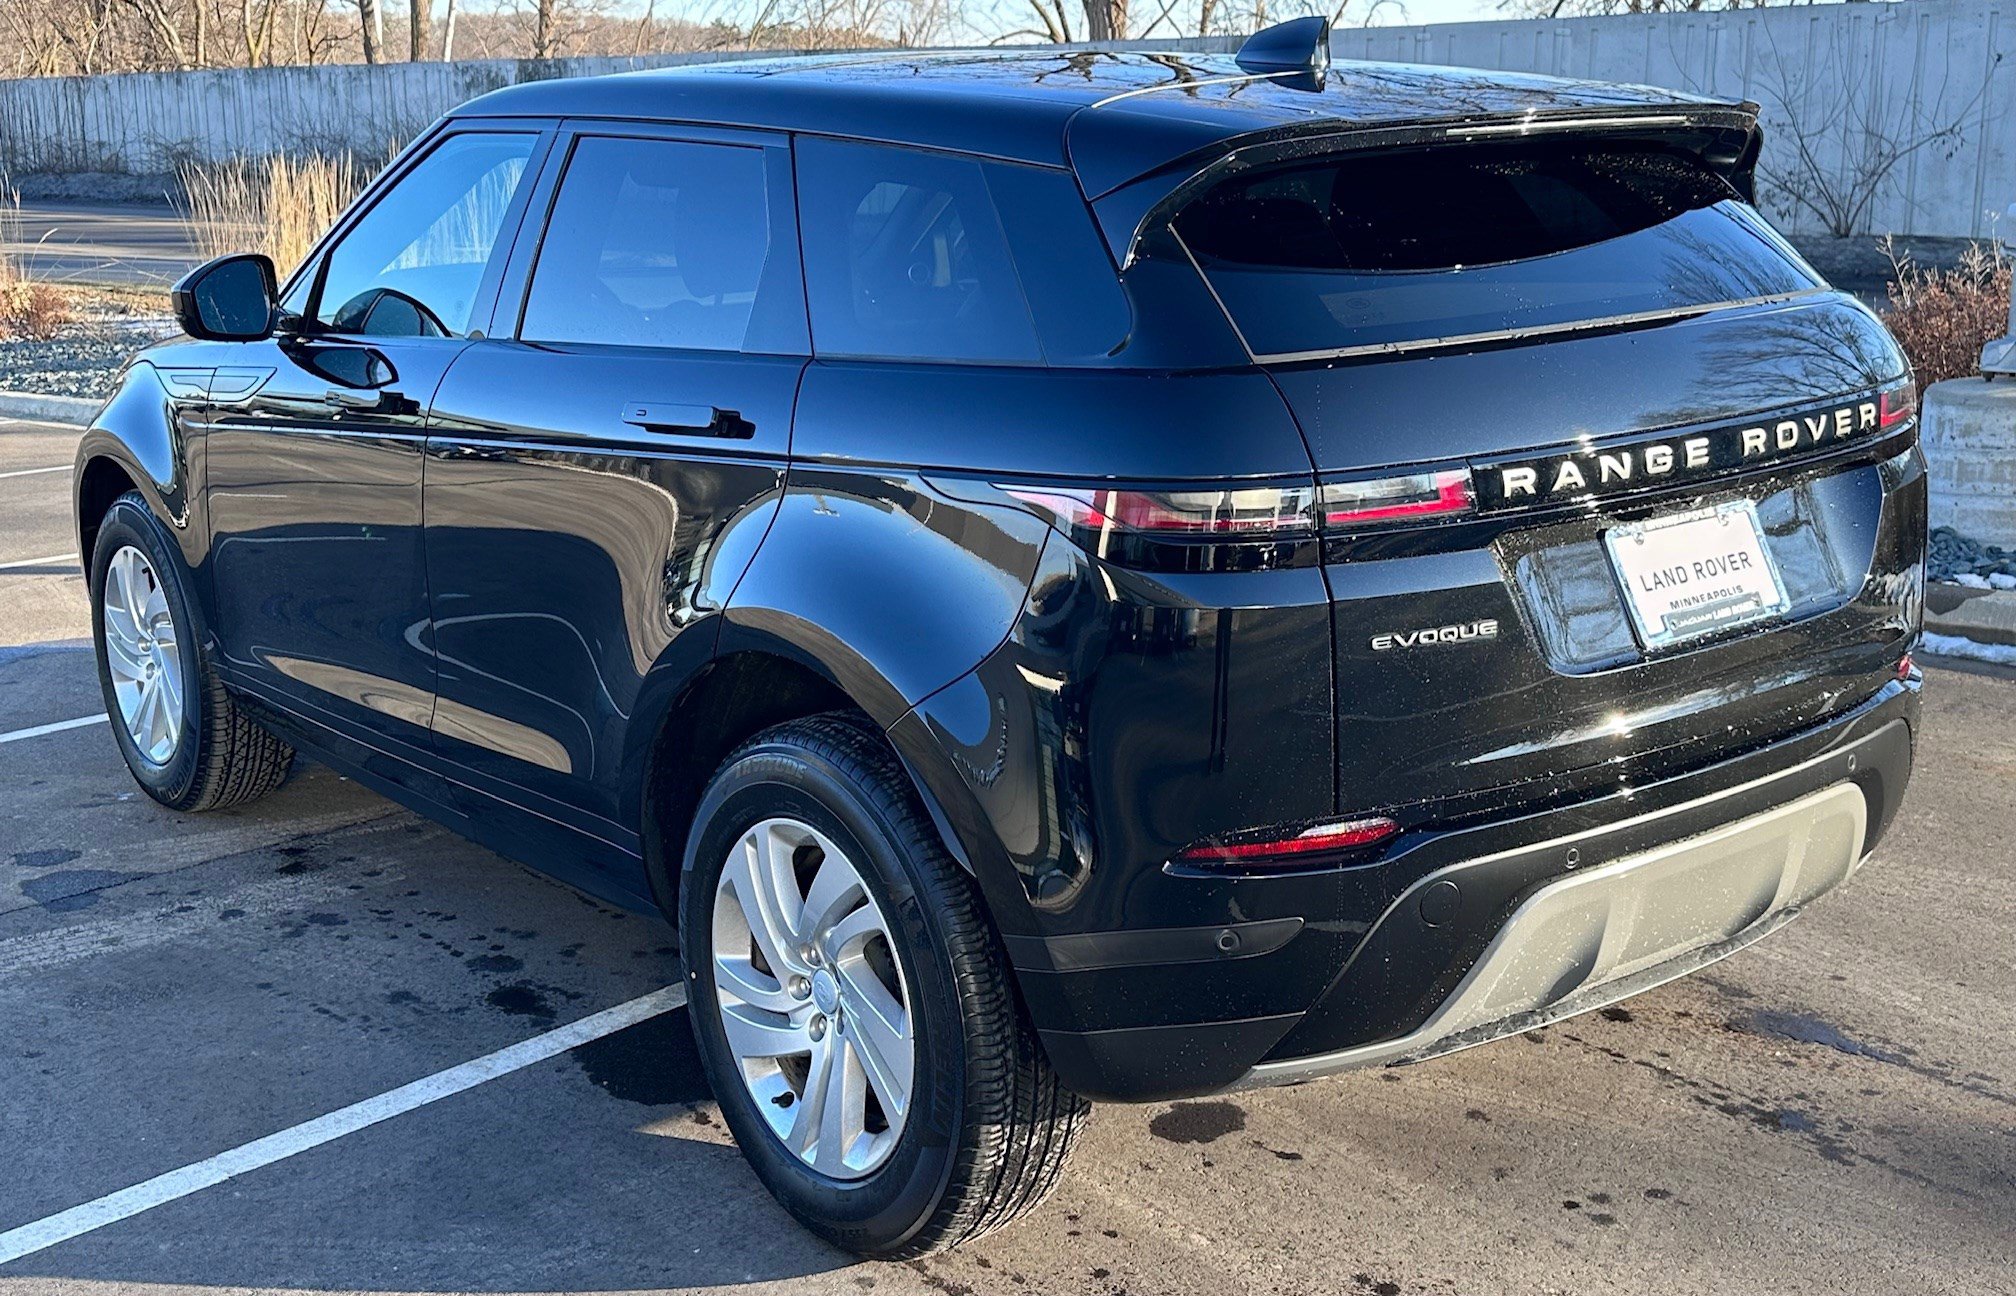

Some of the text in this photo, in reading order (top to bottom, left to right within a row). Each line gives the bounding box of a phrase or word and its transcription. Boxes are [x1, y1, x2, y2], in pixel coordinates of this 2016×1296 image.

[1501, 401, 1878, 498] RANGE ROVER
[1639, 551, 1753, 592] LAND ROVER
[1669, 584, 1745, 611] MINNEAPOLIS
[1370, 618, 1499, 651] EVOQUE
